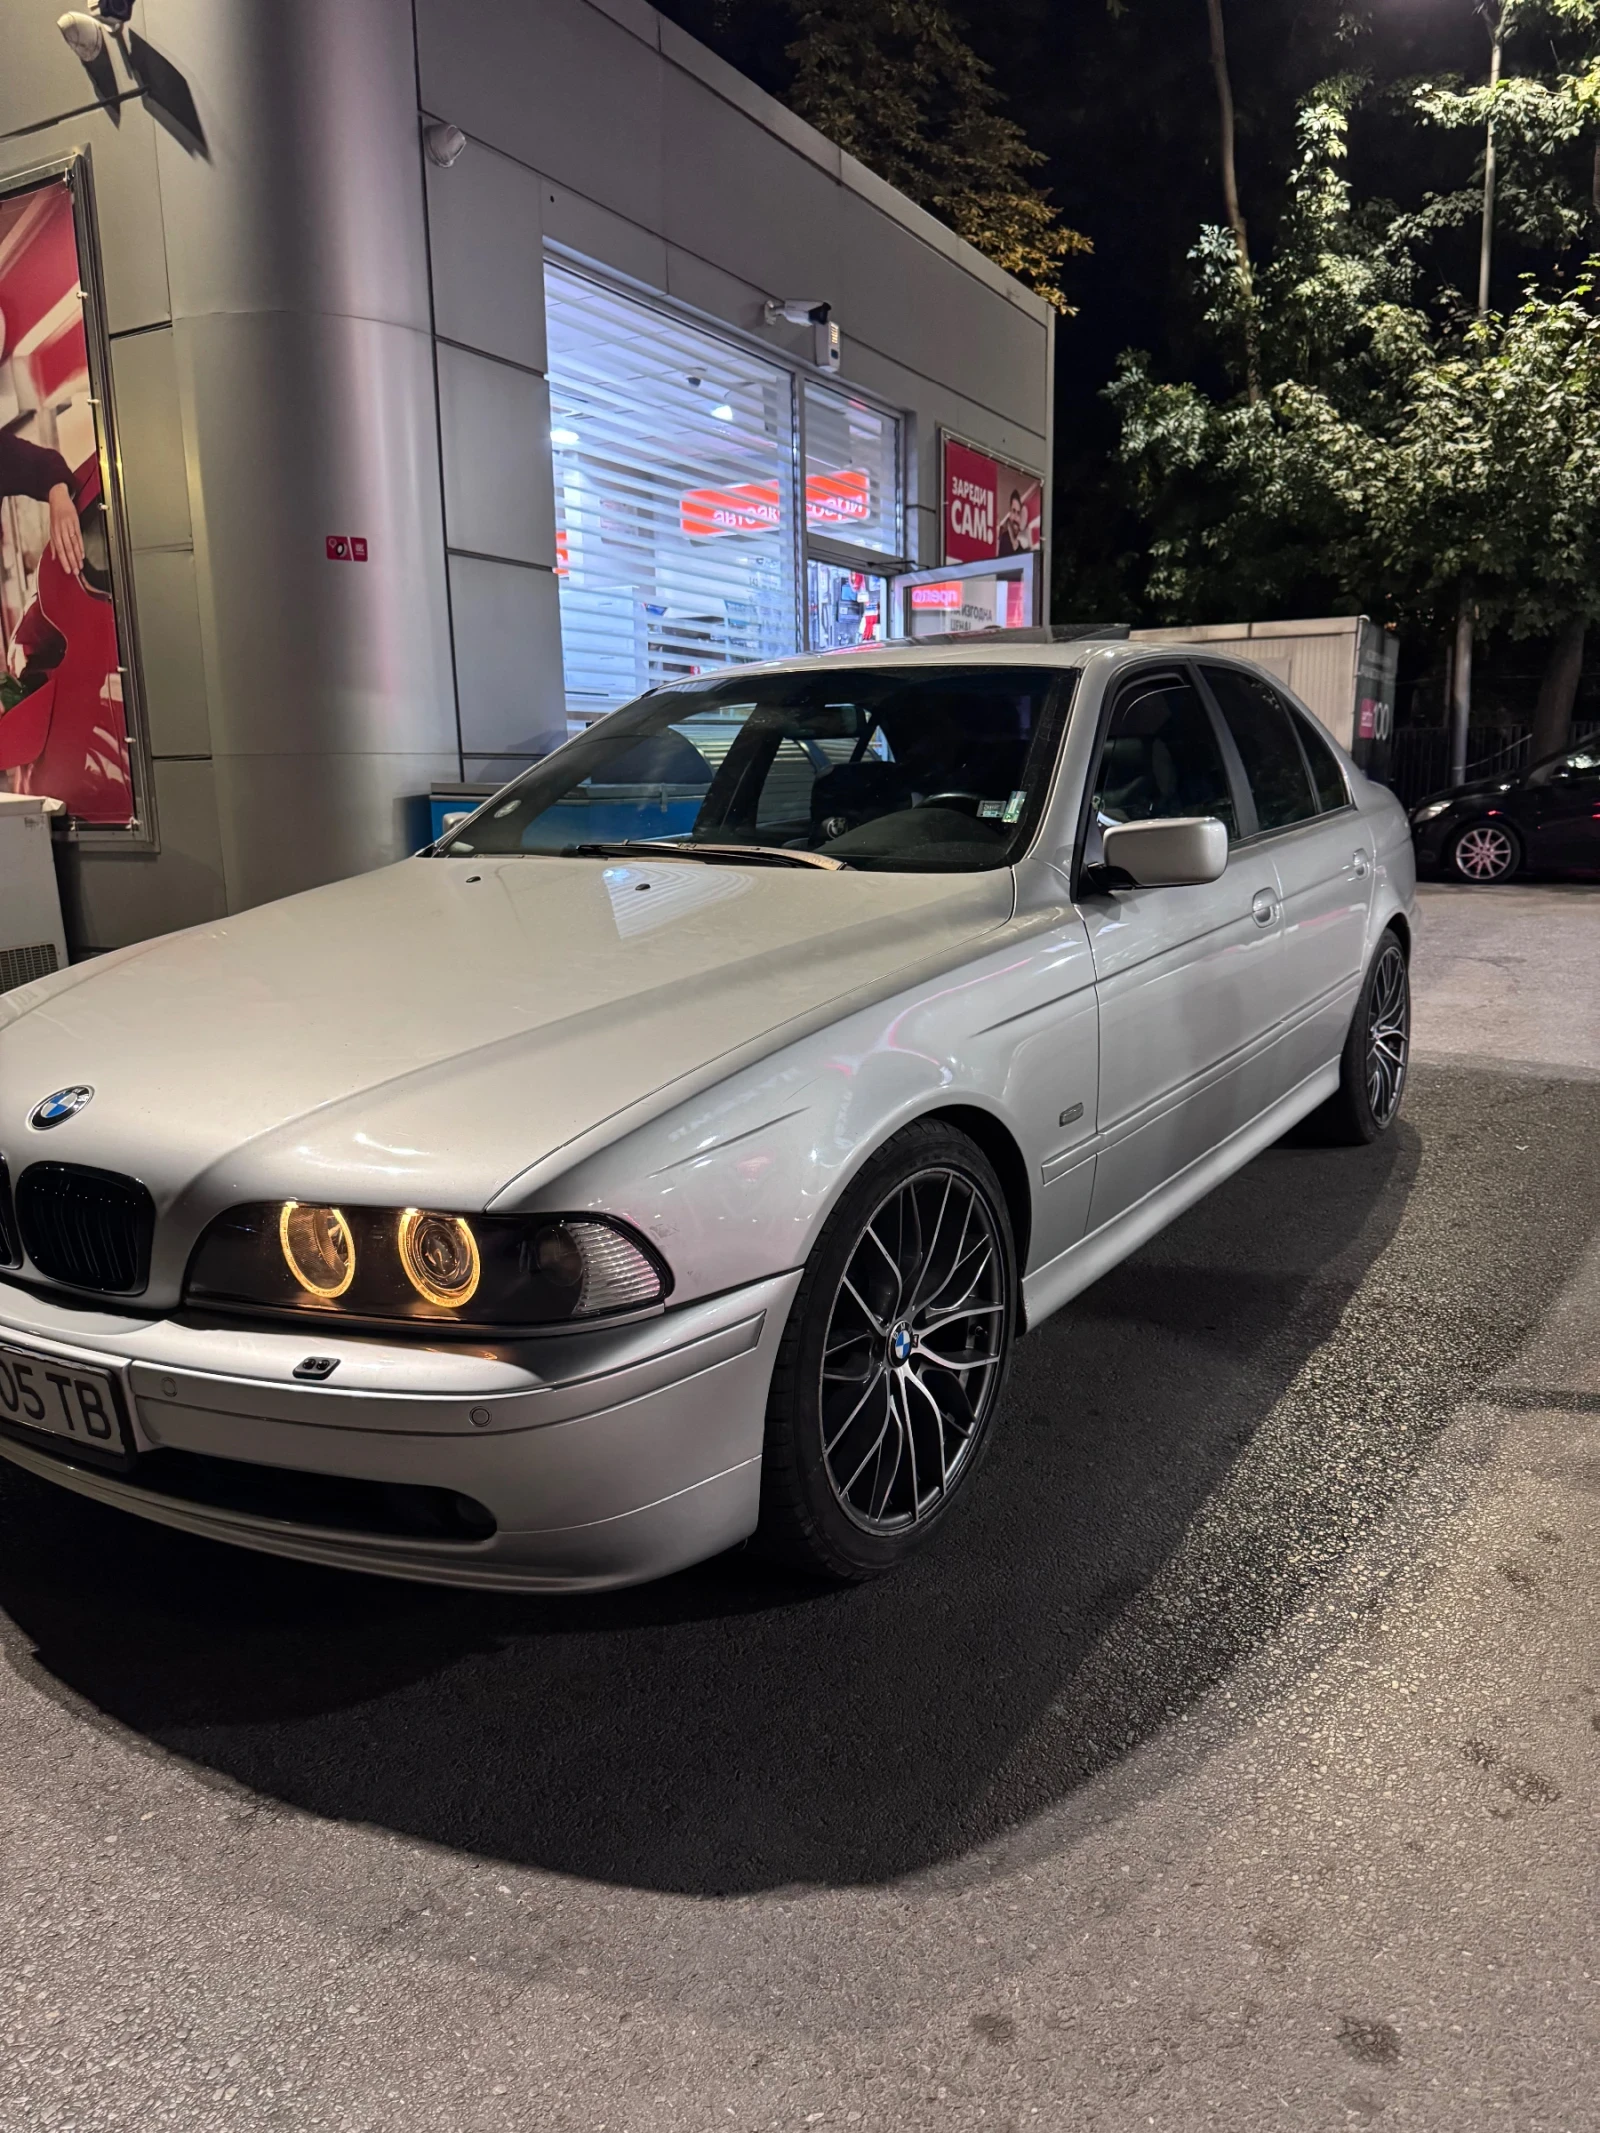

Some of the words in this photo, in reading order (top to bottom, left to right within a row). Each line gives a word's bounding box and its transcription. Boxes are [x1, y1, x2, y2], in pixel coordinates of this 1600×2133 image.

[951, 491, 994, 545] САМ!
[952, 476, 986, 507] ЗАРЕДИ
[44, 1371, 112, 1440] TB
